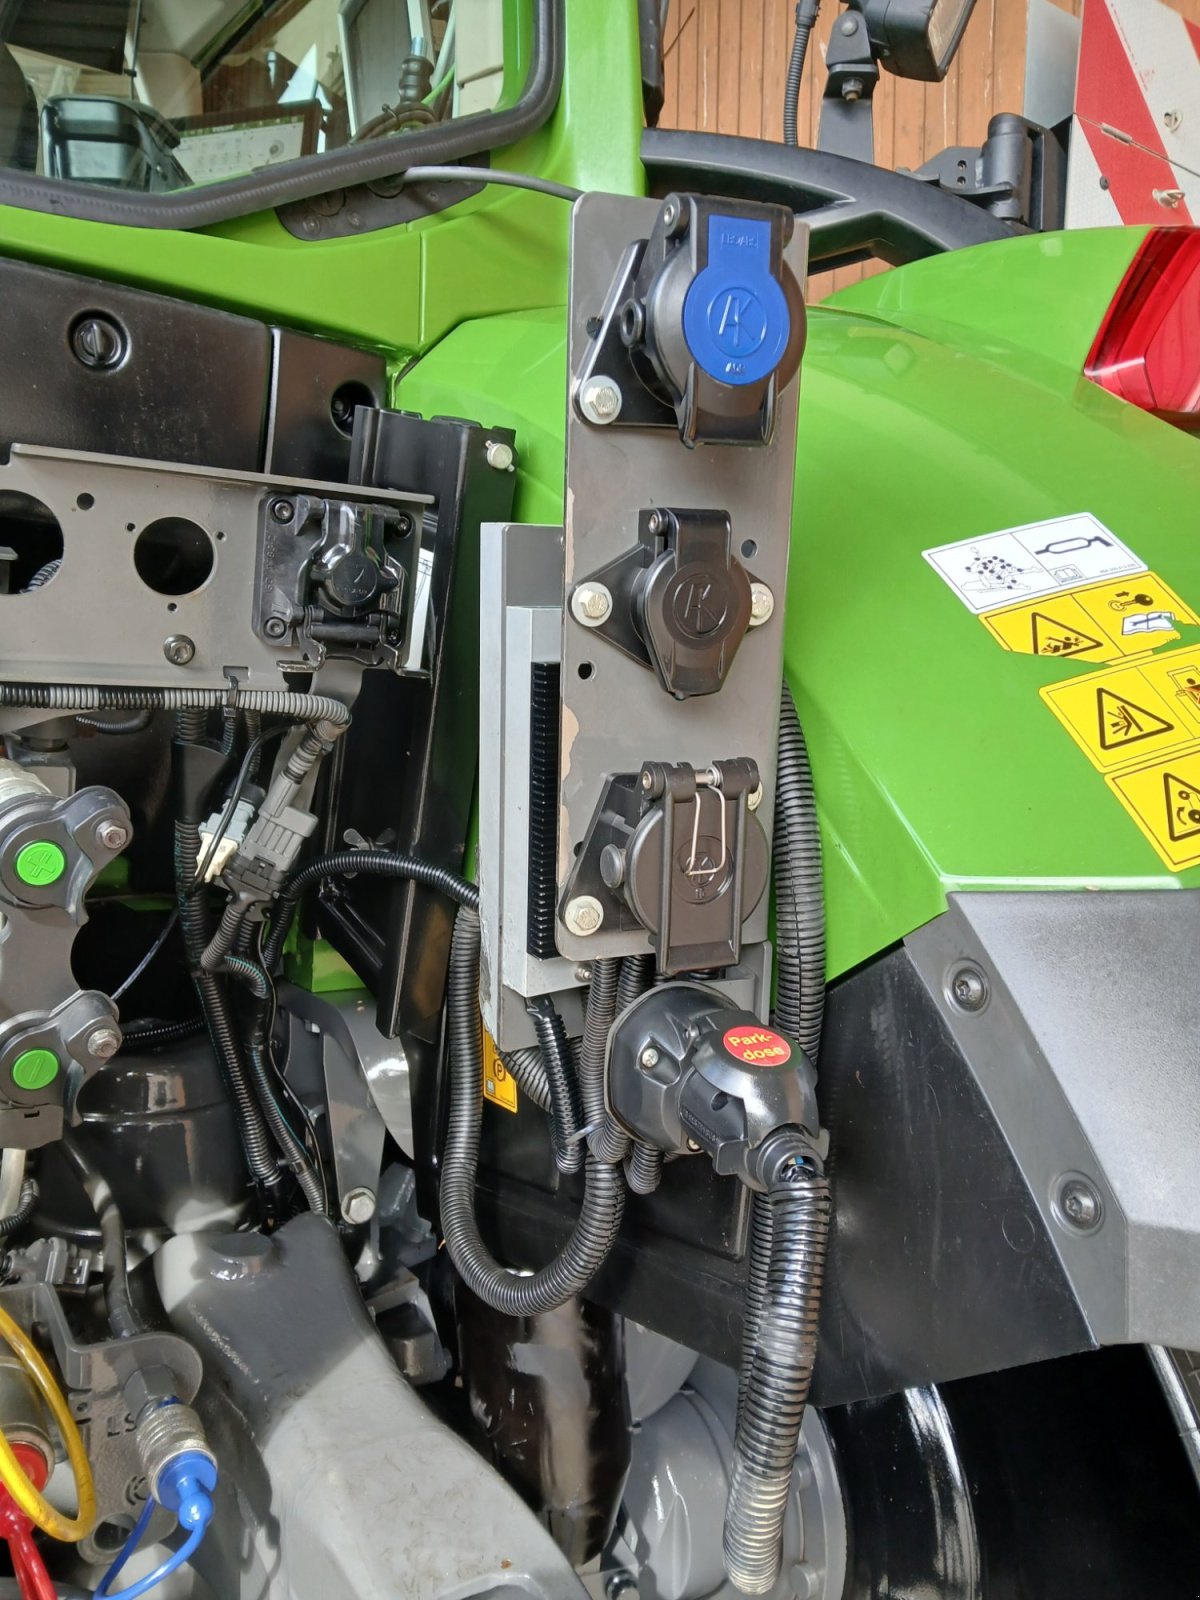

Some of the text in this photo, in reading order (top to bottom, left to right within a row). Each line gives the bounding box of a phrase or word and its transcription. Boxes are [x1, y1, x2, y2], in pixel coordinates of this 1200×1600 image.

[727, 1032, 773, 1047] Park-
[742, 1046, 785, 1060] dose
[107, 1412, 137, 1437] LS
